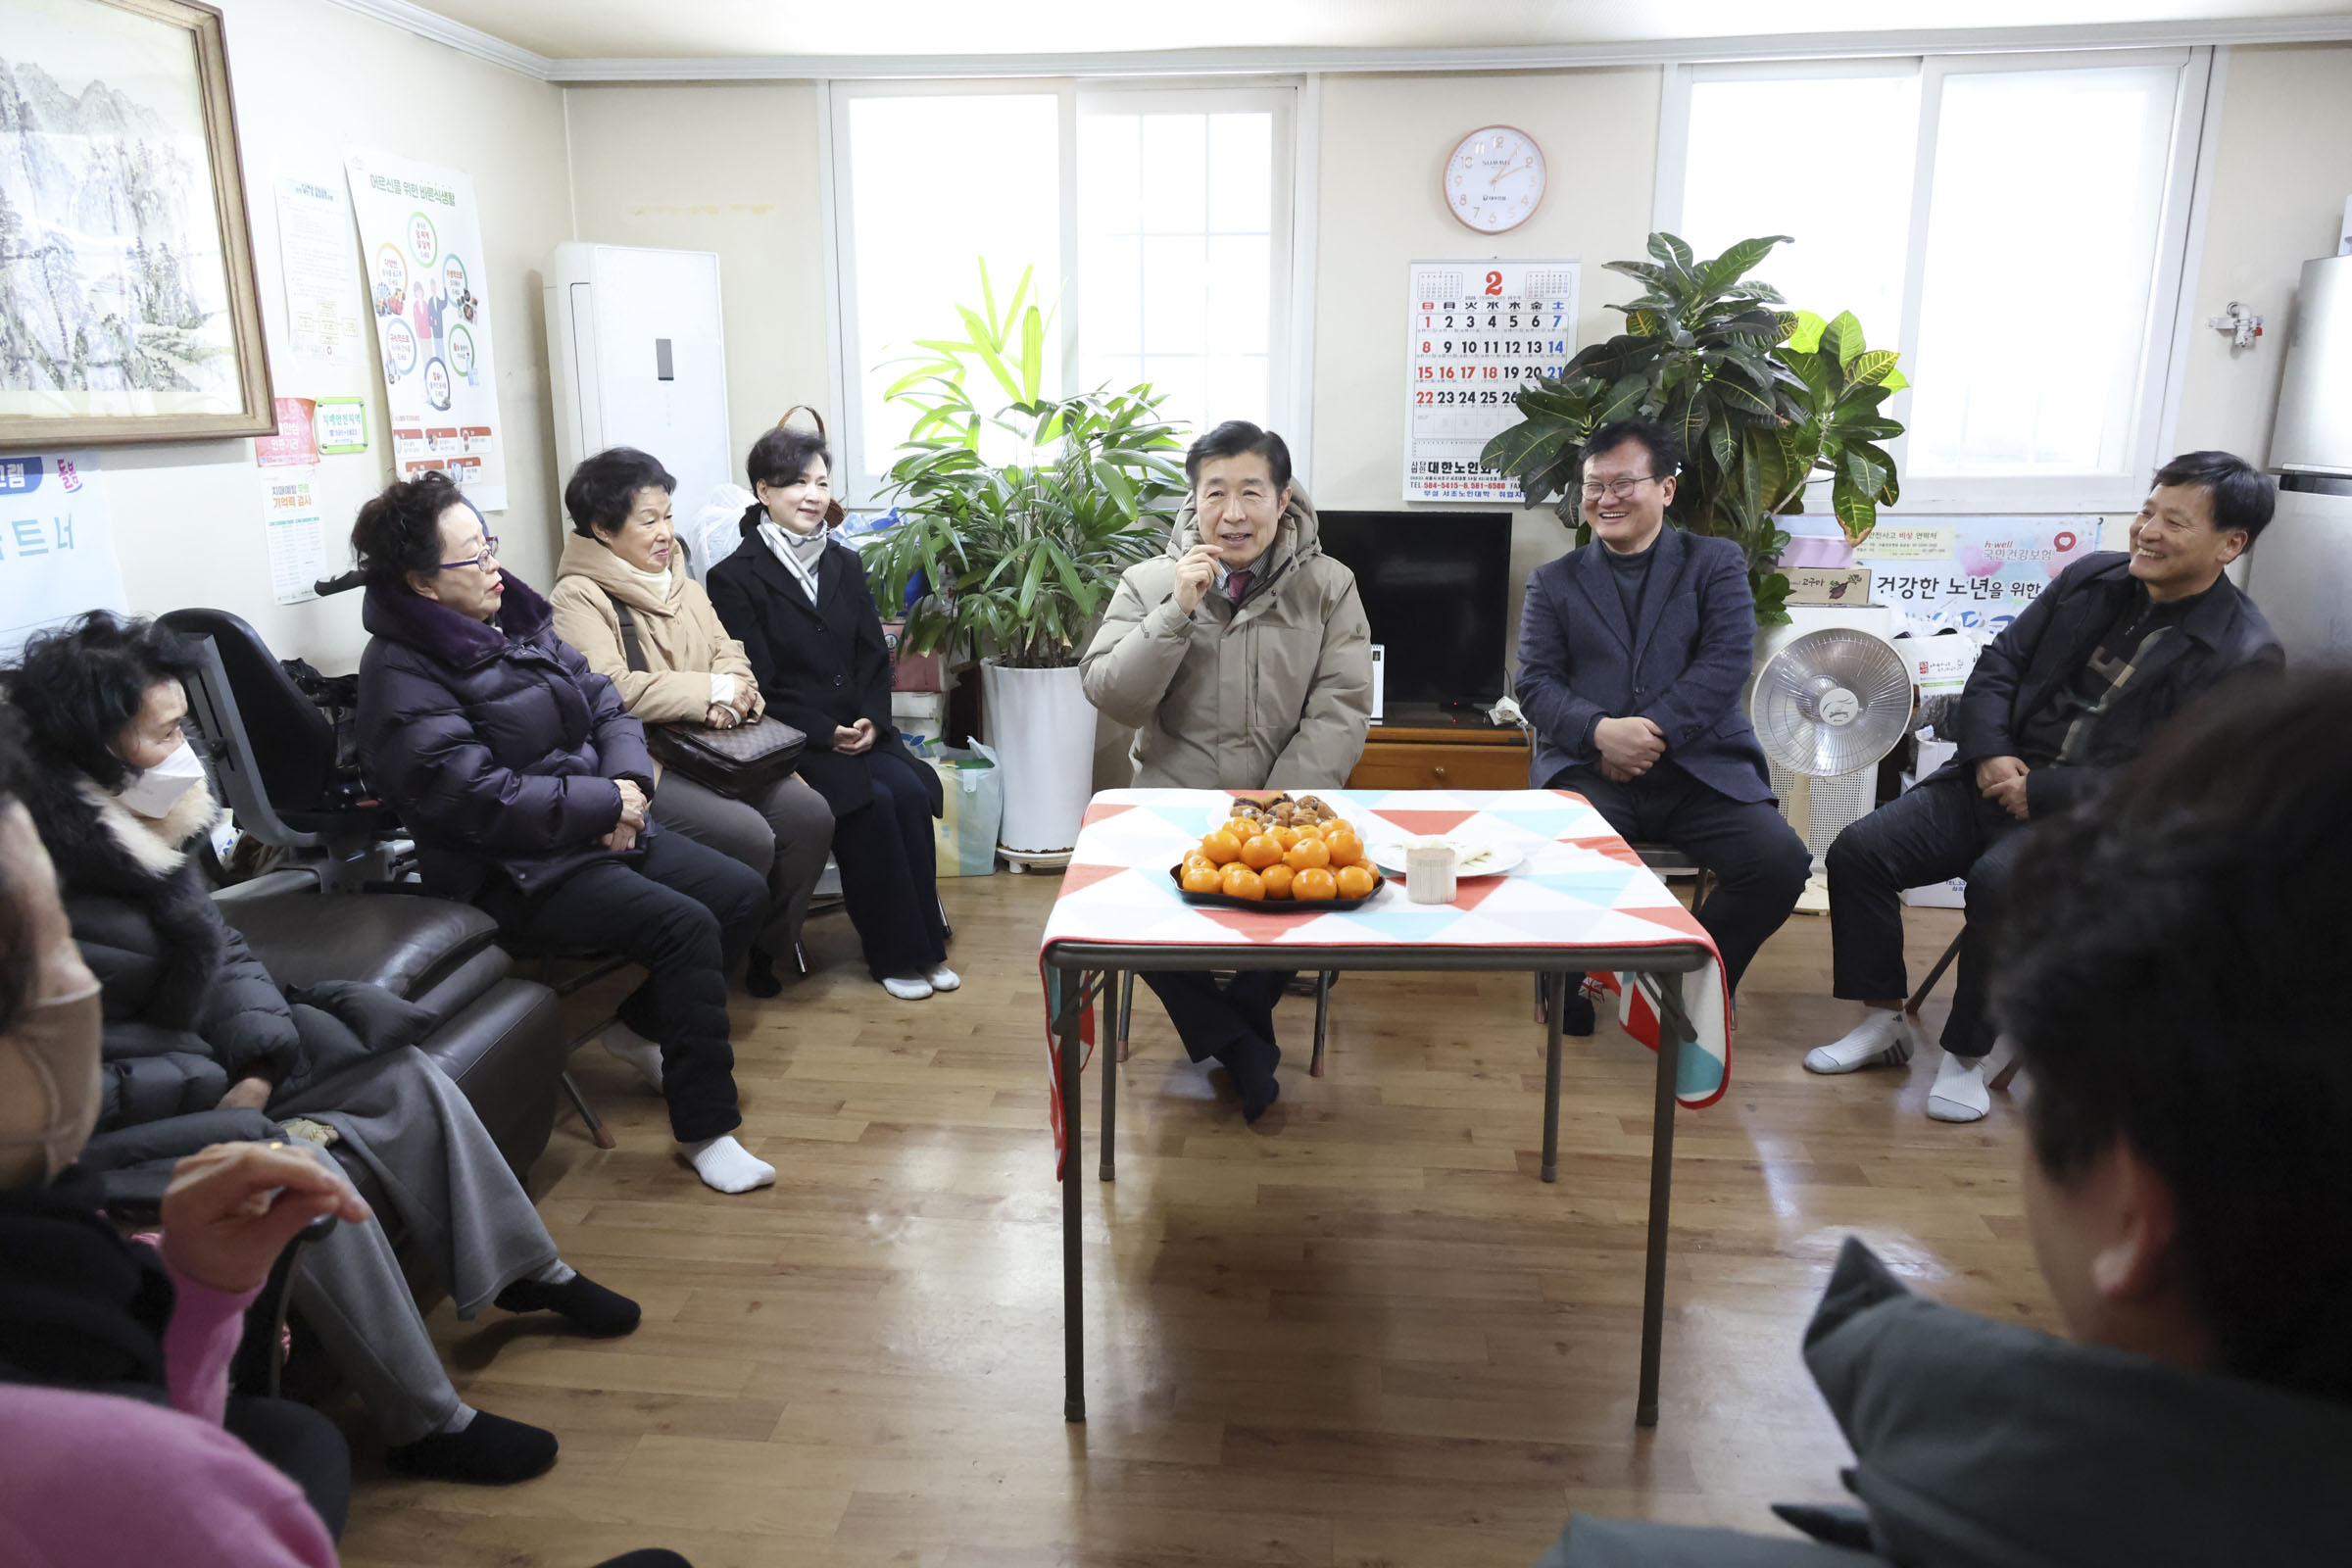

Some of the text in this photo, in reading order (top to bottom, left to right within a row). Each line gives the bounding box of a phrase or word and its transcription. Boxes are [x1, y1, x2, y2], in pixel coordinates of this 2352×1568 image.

[1460, 157, 1473, 169] 10
[403, 181, 418, 199] 위한
[1459, 194, 1466, 206] 8
[1521, 194, 1529, 205] 4
[1474, 206, 1481, 219] 7
[1485, 270, 1502, 295] 2
[1425, 316, 1561, 327] 1 2 3 4 5 6 7
[1422, 341, 1563, 353] 8 9 10 11 12 13 14
[1418, 367, 1563, 378] 15 16 17 18 19 20 21
[1416, 392, 1433, 404] 22
[1438, 392, 1454, 404] 23
[1458, 392, 1476, 404] 24
[1480, 392, 1497, 404] 25
[0, 513, 74, 561] 트너
[1898, 531, 1913, 540] 비상
[1984, 549, 2052, 562] 국민건강보험
[1801, 577, 1825, 587] 고구마
[1877, 576, 2041, 600] 건강한 노년을 위한
